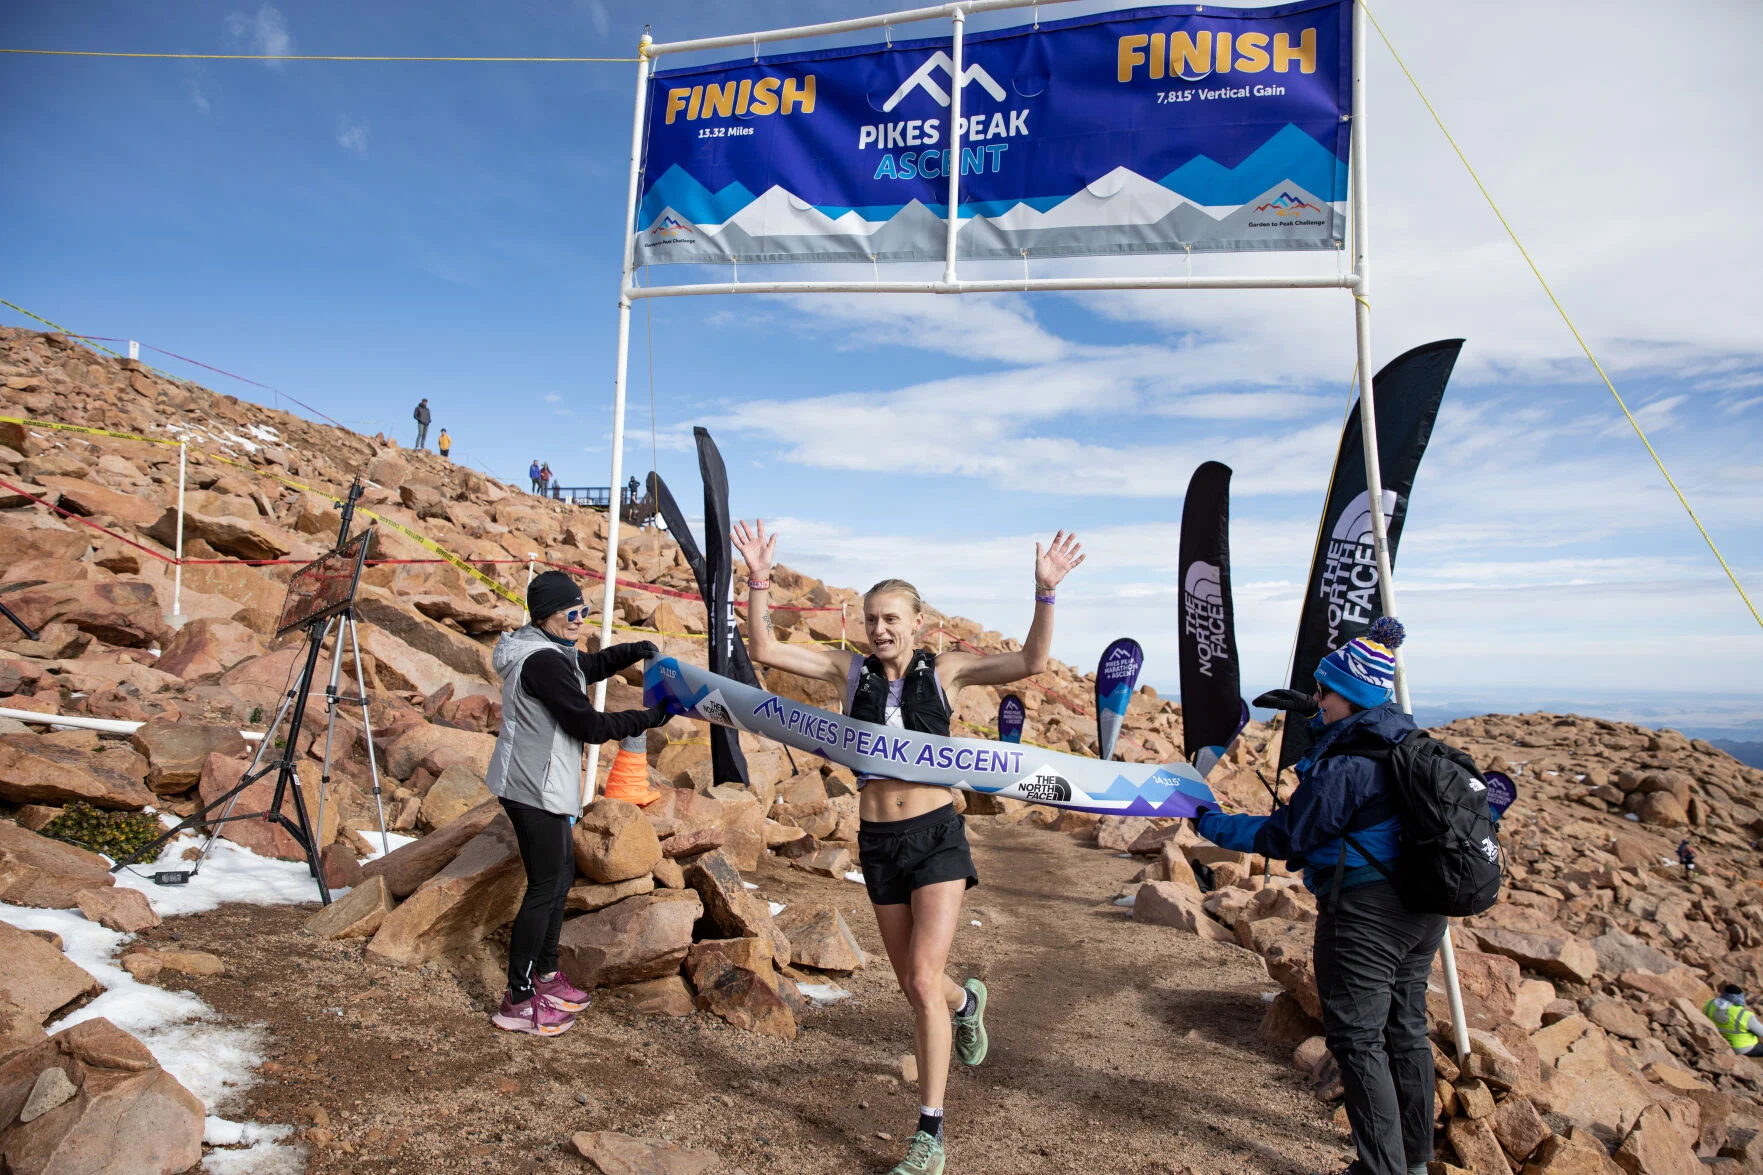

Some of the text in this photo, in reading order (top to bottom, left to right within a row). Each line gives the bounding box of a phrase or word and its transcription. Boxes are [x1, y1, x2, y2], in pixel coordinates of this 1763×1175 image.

[1117, 27, 1317, 83] FINISH
[665, 74, 817, 125] FINISH
[1156, 84, 1286, 104] 7,815' Vertical Gain
[698, 126, 754, 139] 13.32 Miles
[858, 118, 940, 149] PIKES
[1295, 219, 1326, 227] Challenge
[1320, 541, 1342, 599] THE
[1342, 545, 1379, 625] FACE
[1184, 591, 1197, 636] THE
[1326, 542, 1357, 651] NORTH
[1193, 597, 1213, 677] NORTH
[1207, 603, 1229, 659] FACE
[787, 709, 1024, 774] PIKES PEAK ASCENT
[1018, 783, 1055, 793] NORTH
[1026, 791, 1053, 801] FACE
[1036, 775, 1056, 785] THE
